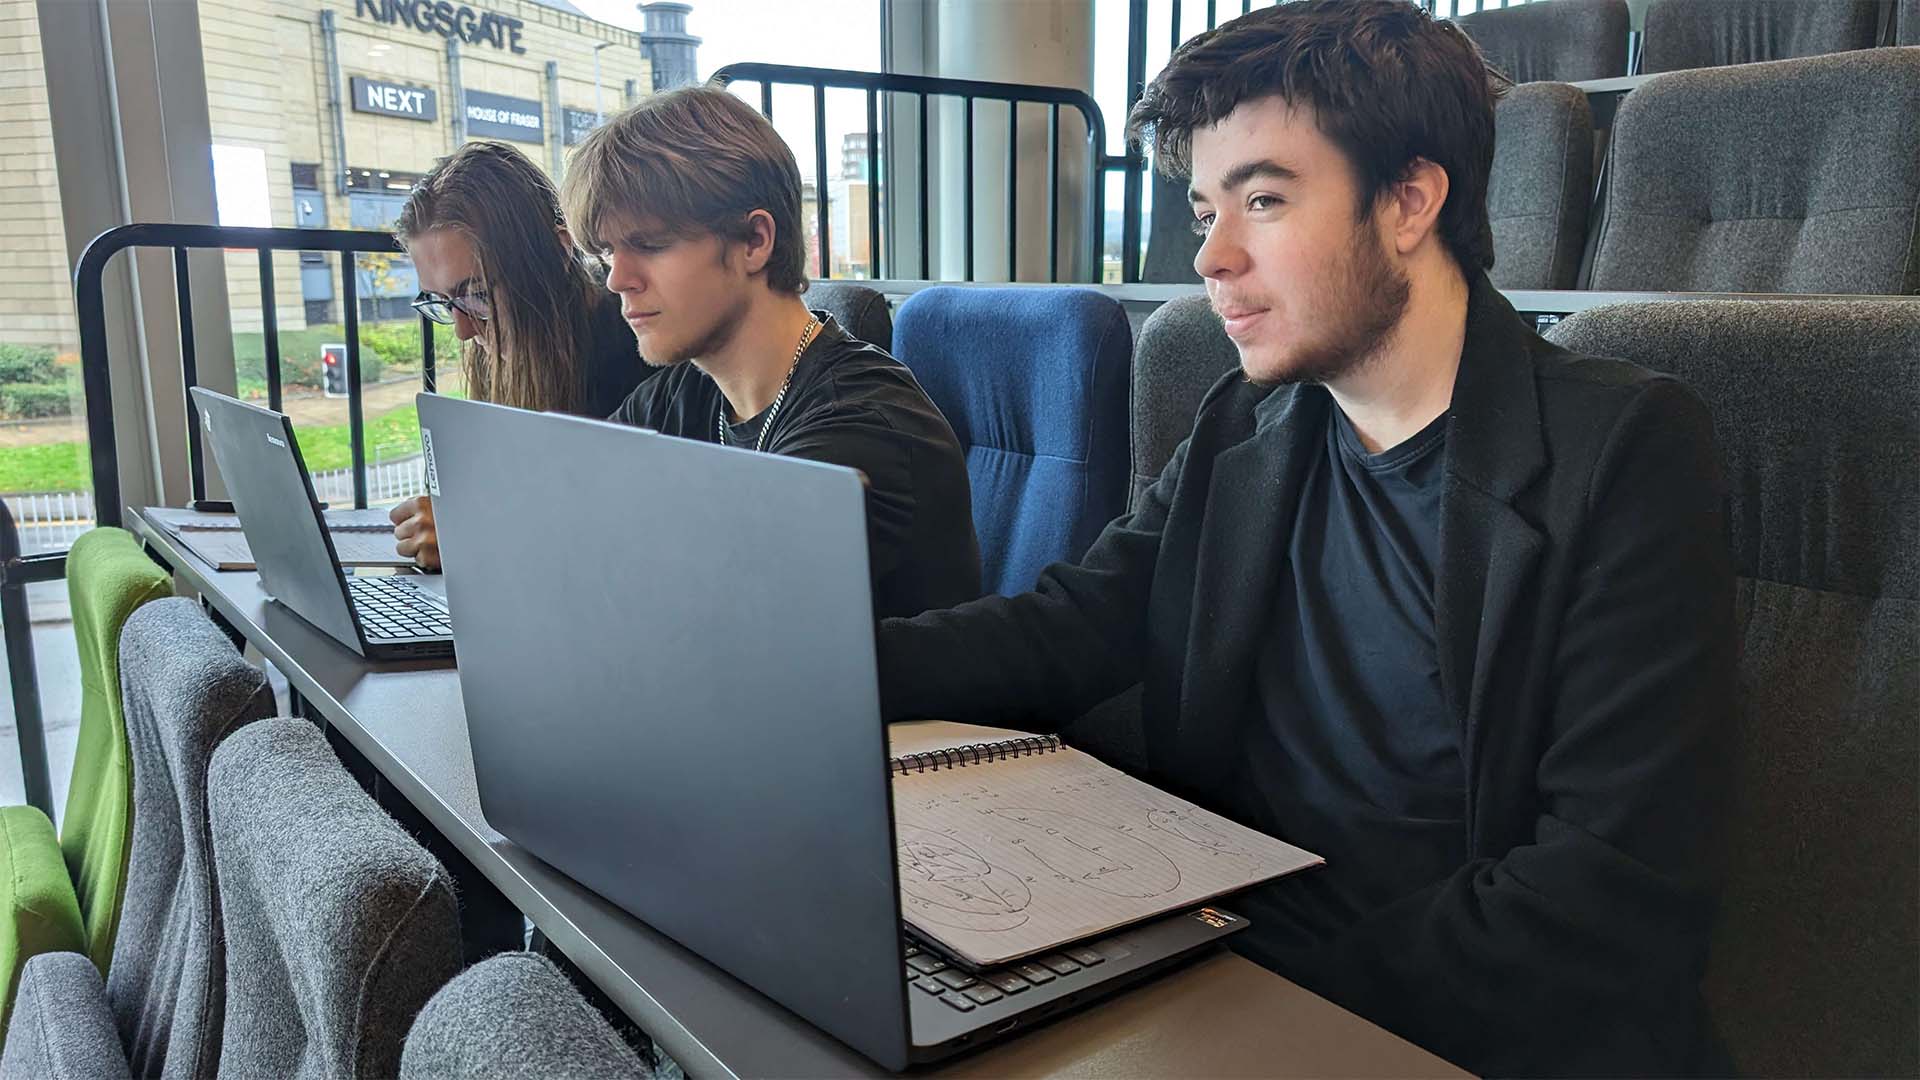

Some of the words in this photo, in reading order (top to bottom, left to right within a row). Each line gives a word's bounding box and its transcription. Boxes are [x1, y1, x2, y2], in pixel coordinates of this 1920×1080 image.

[368, 86, 425, 114] NEXT
[467, 106, 497, 123] HOUSE
[498, 111, 509, 124] OF
[511, 112, 539, 128] FRASER
[424, 434, 437, 490] Lenovo
